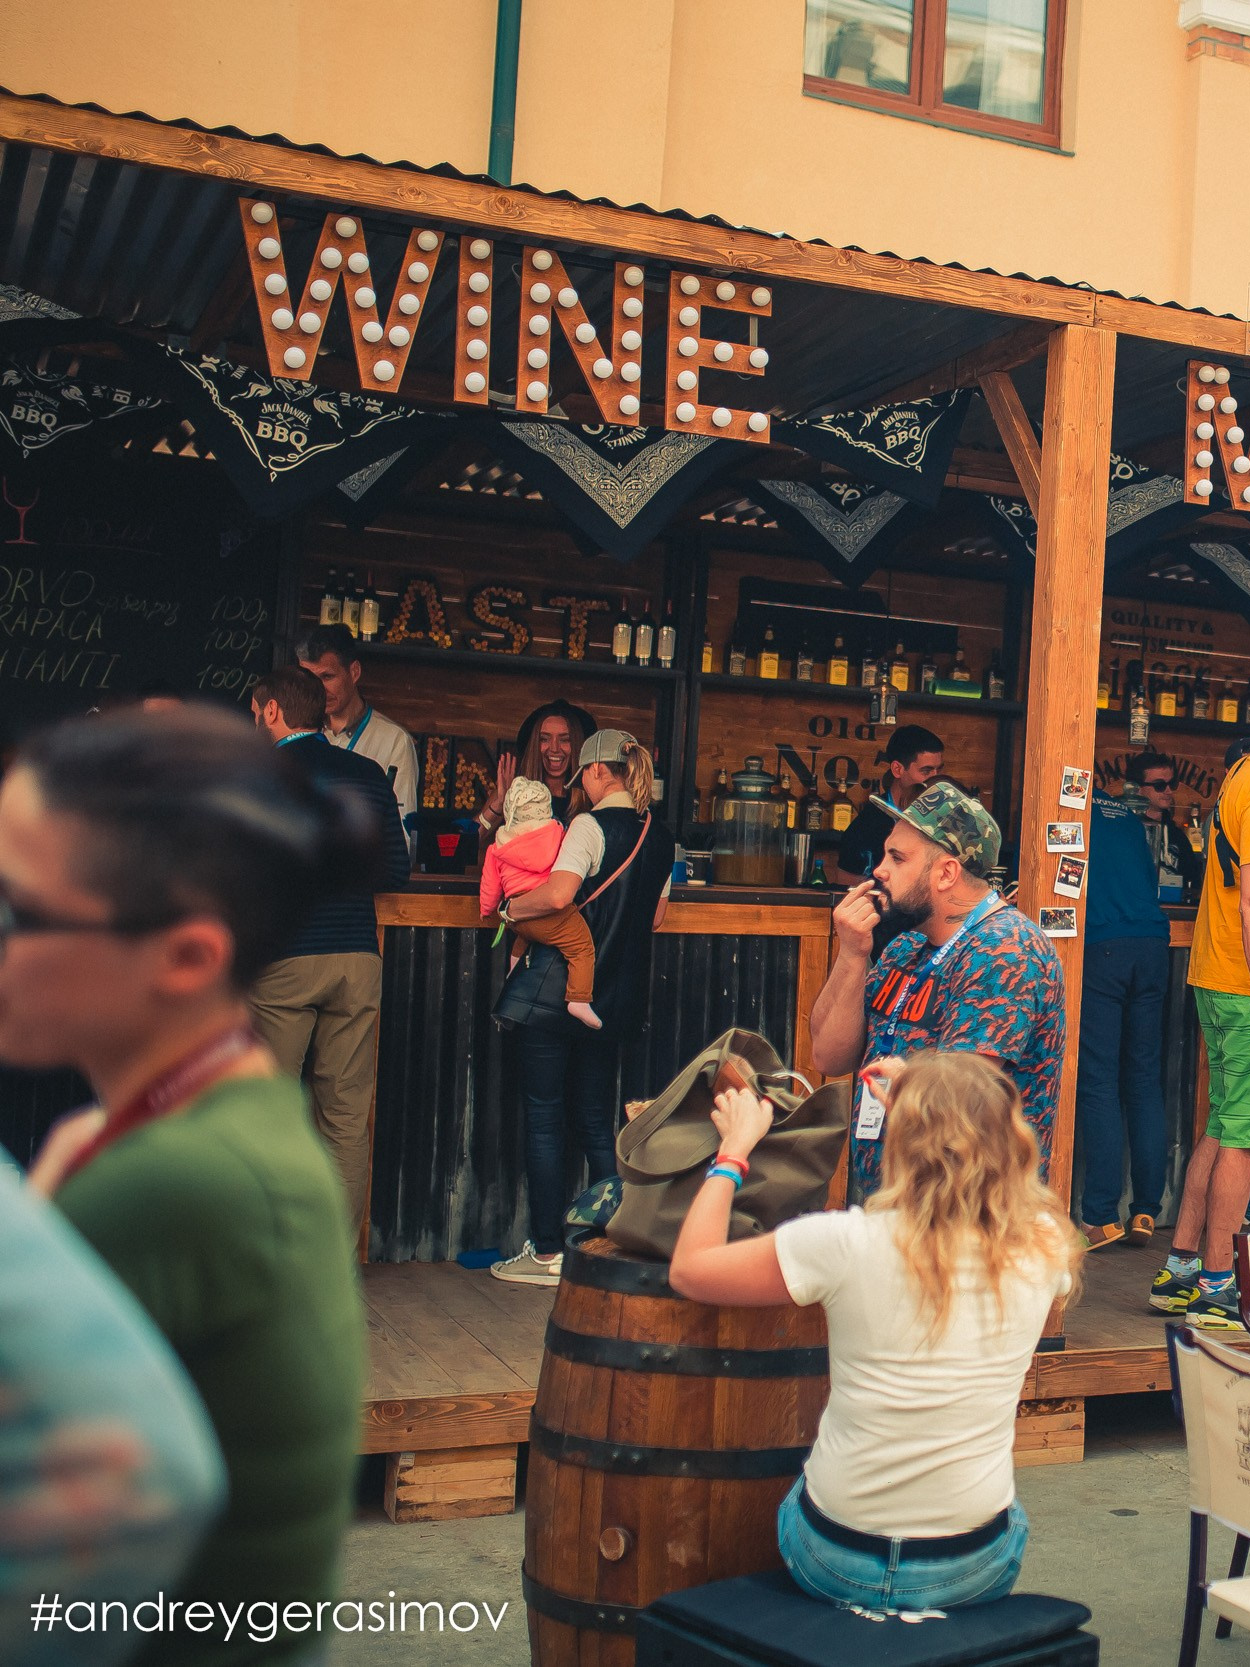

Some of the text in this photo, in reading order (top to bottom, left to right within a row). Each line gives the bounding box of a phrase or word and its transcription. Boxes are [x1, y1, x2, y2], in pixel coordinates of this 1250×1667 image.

[238, 197, 774, 444] WINE
[10, 404, 58, 432] BBQ
[261, 402, 283, 415] JACK
[881, 415, 895, 430] JACK
[255, 420, 308, 453] BBQ
[884, 426, 921, 450] BBQ
[1111, 609, 1198, 633] QUALITY
